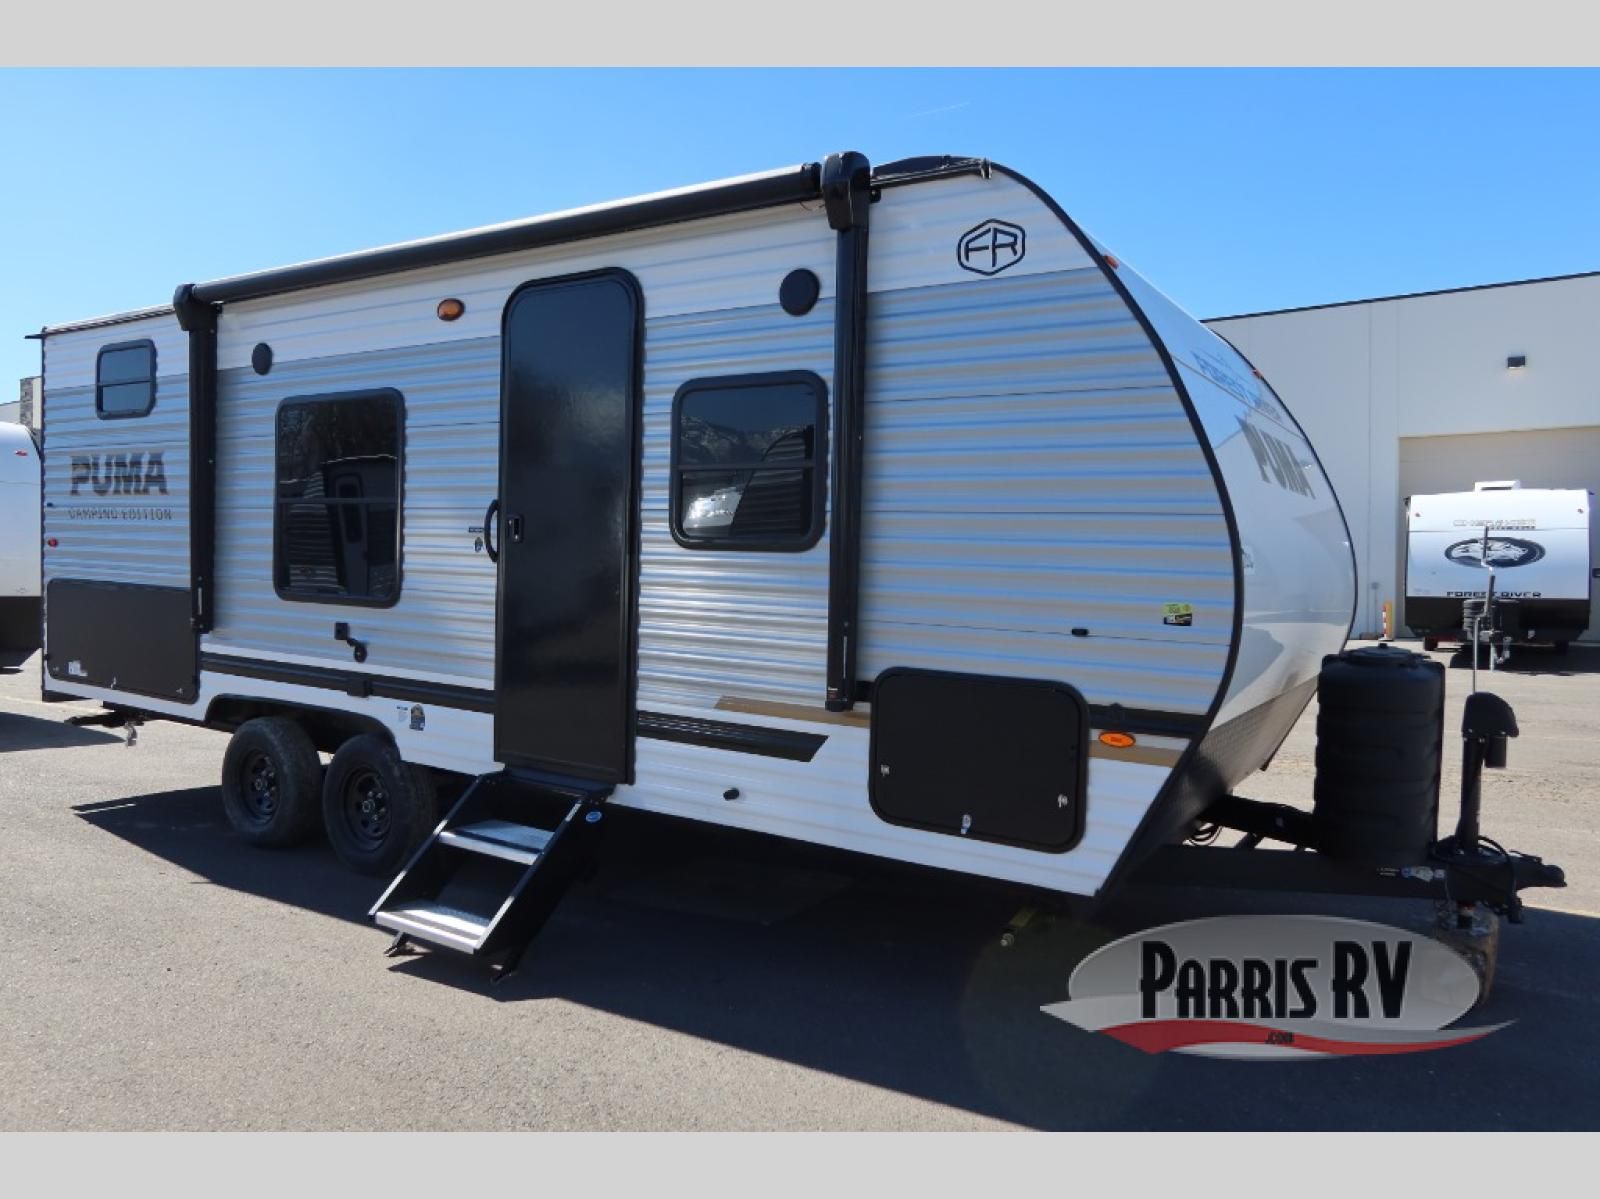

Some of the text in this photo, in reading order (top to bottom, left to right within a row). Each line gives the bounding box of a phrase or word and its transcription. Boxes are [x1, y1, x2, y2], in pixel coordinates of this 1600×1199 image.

[964, 227, 1018, 268] FR
[70, 452, 169, 496] PUMA
[121, 507, 173, 521] EDITION
